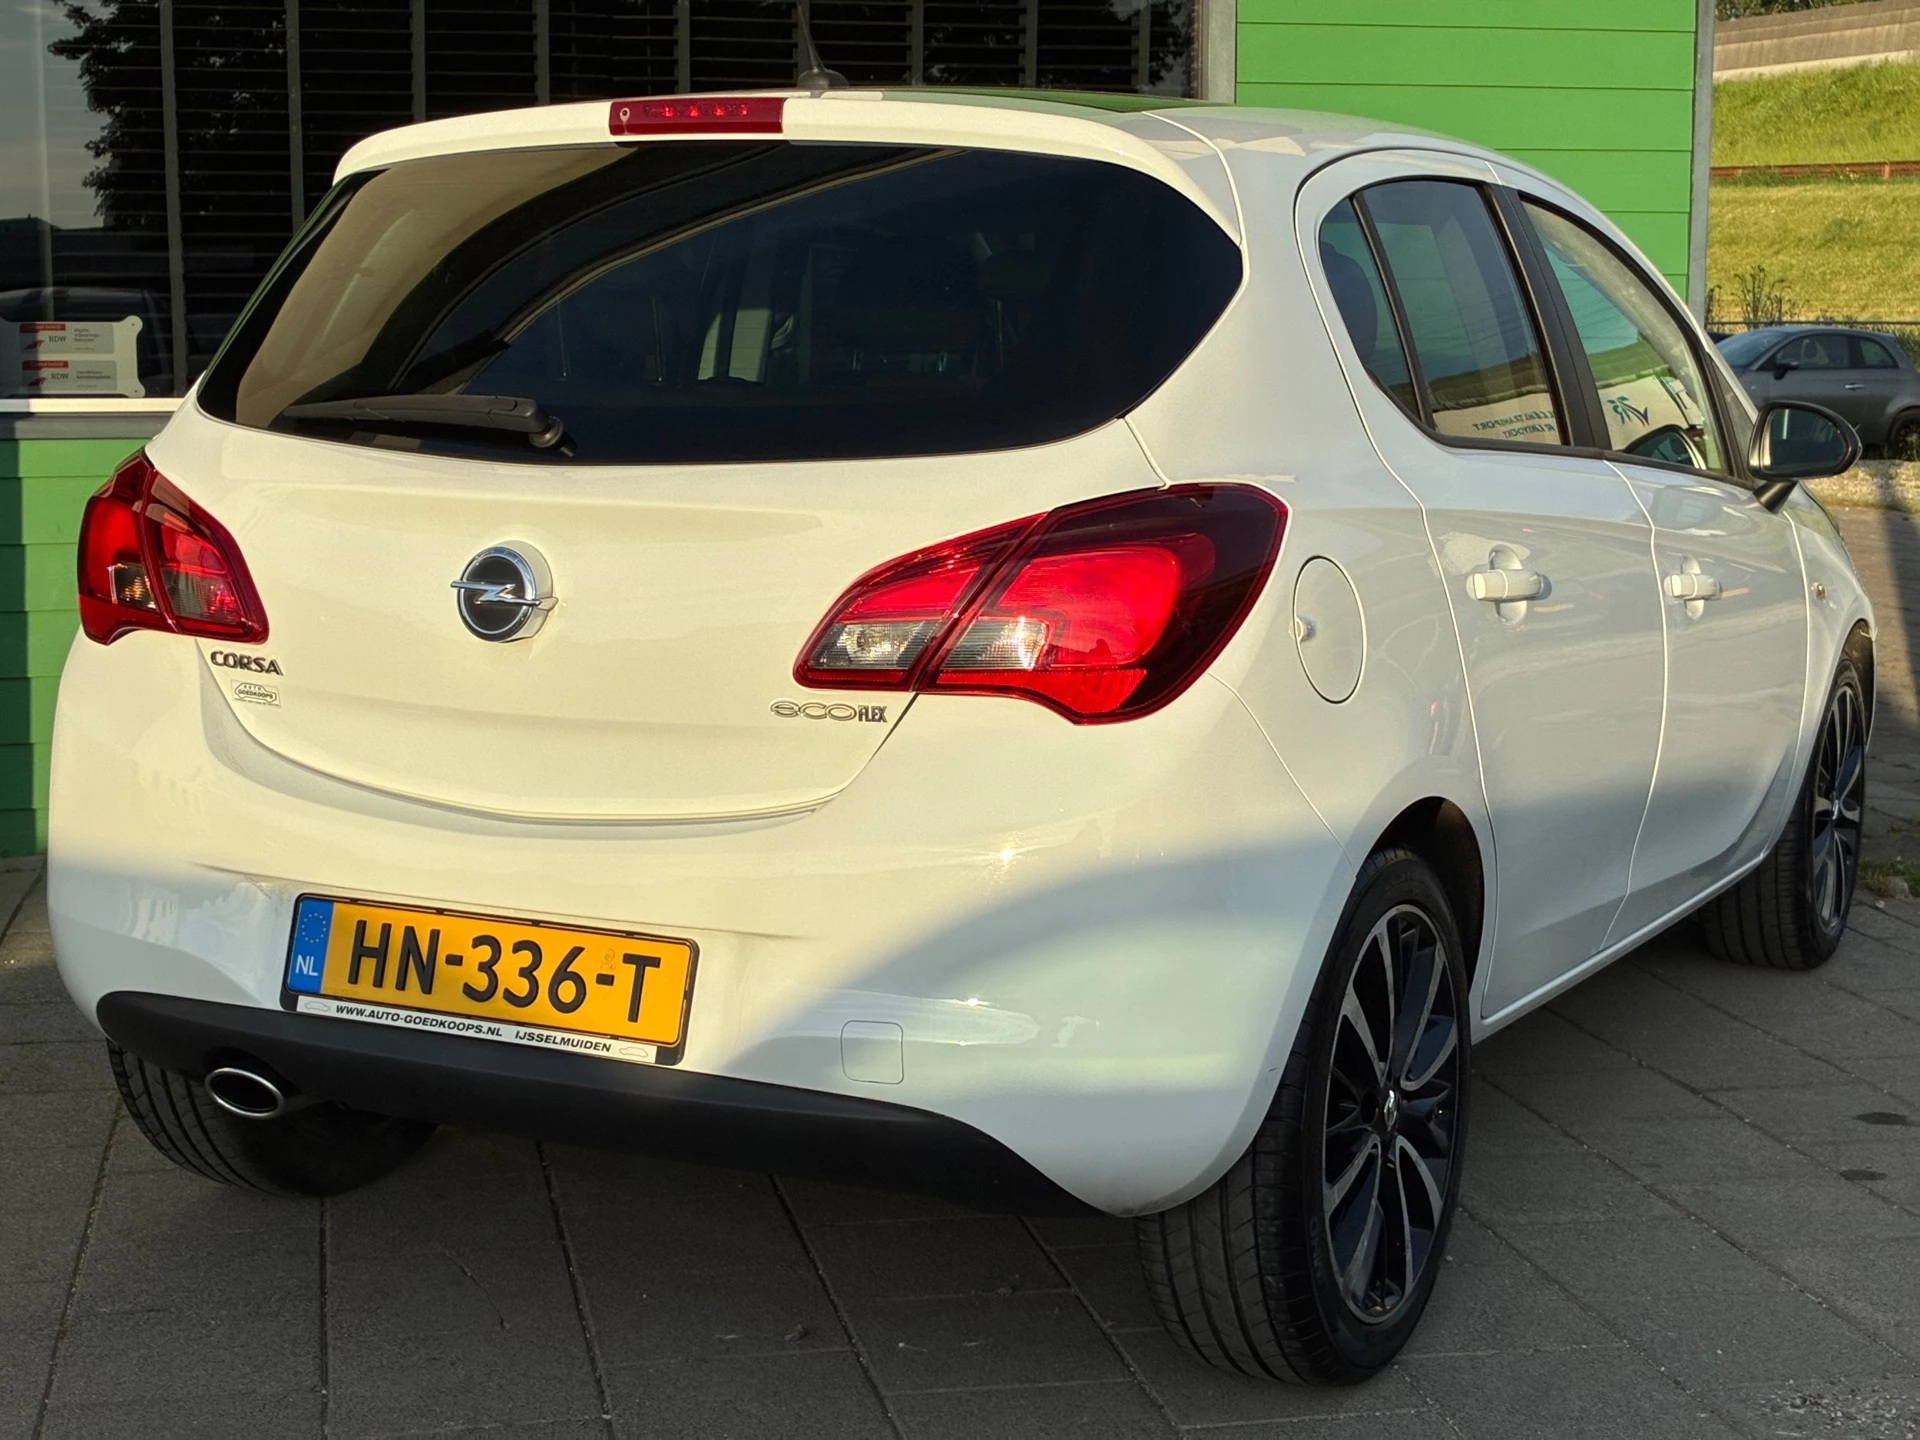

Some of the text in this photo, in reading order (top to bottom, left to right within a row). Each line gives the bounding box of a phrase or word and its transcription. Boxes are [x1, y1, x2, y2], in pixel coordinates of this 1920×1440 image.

[210, 650, 284, 676] CORSA
[295, 954, 319, 977] NL
[347, 919, 661, 1023] HN-336-T
[335, 1004, 612, 1053] WWW.AUTO-GOEDKOOPS.NL IJSSELMUIDEN
